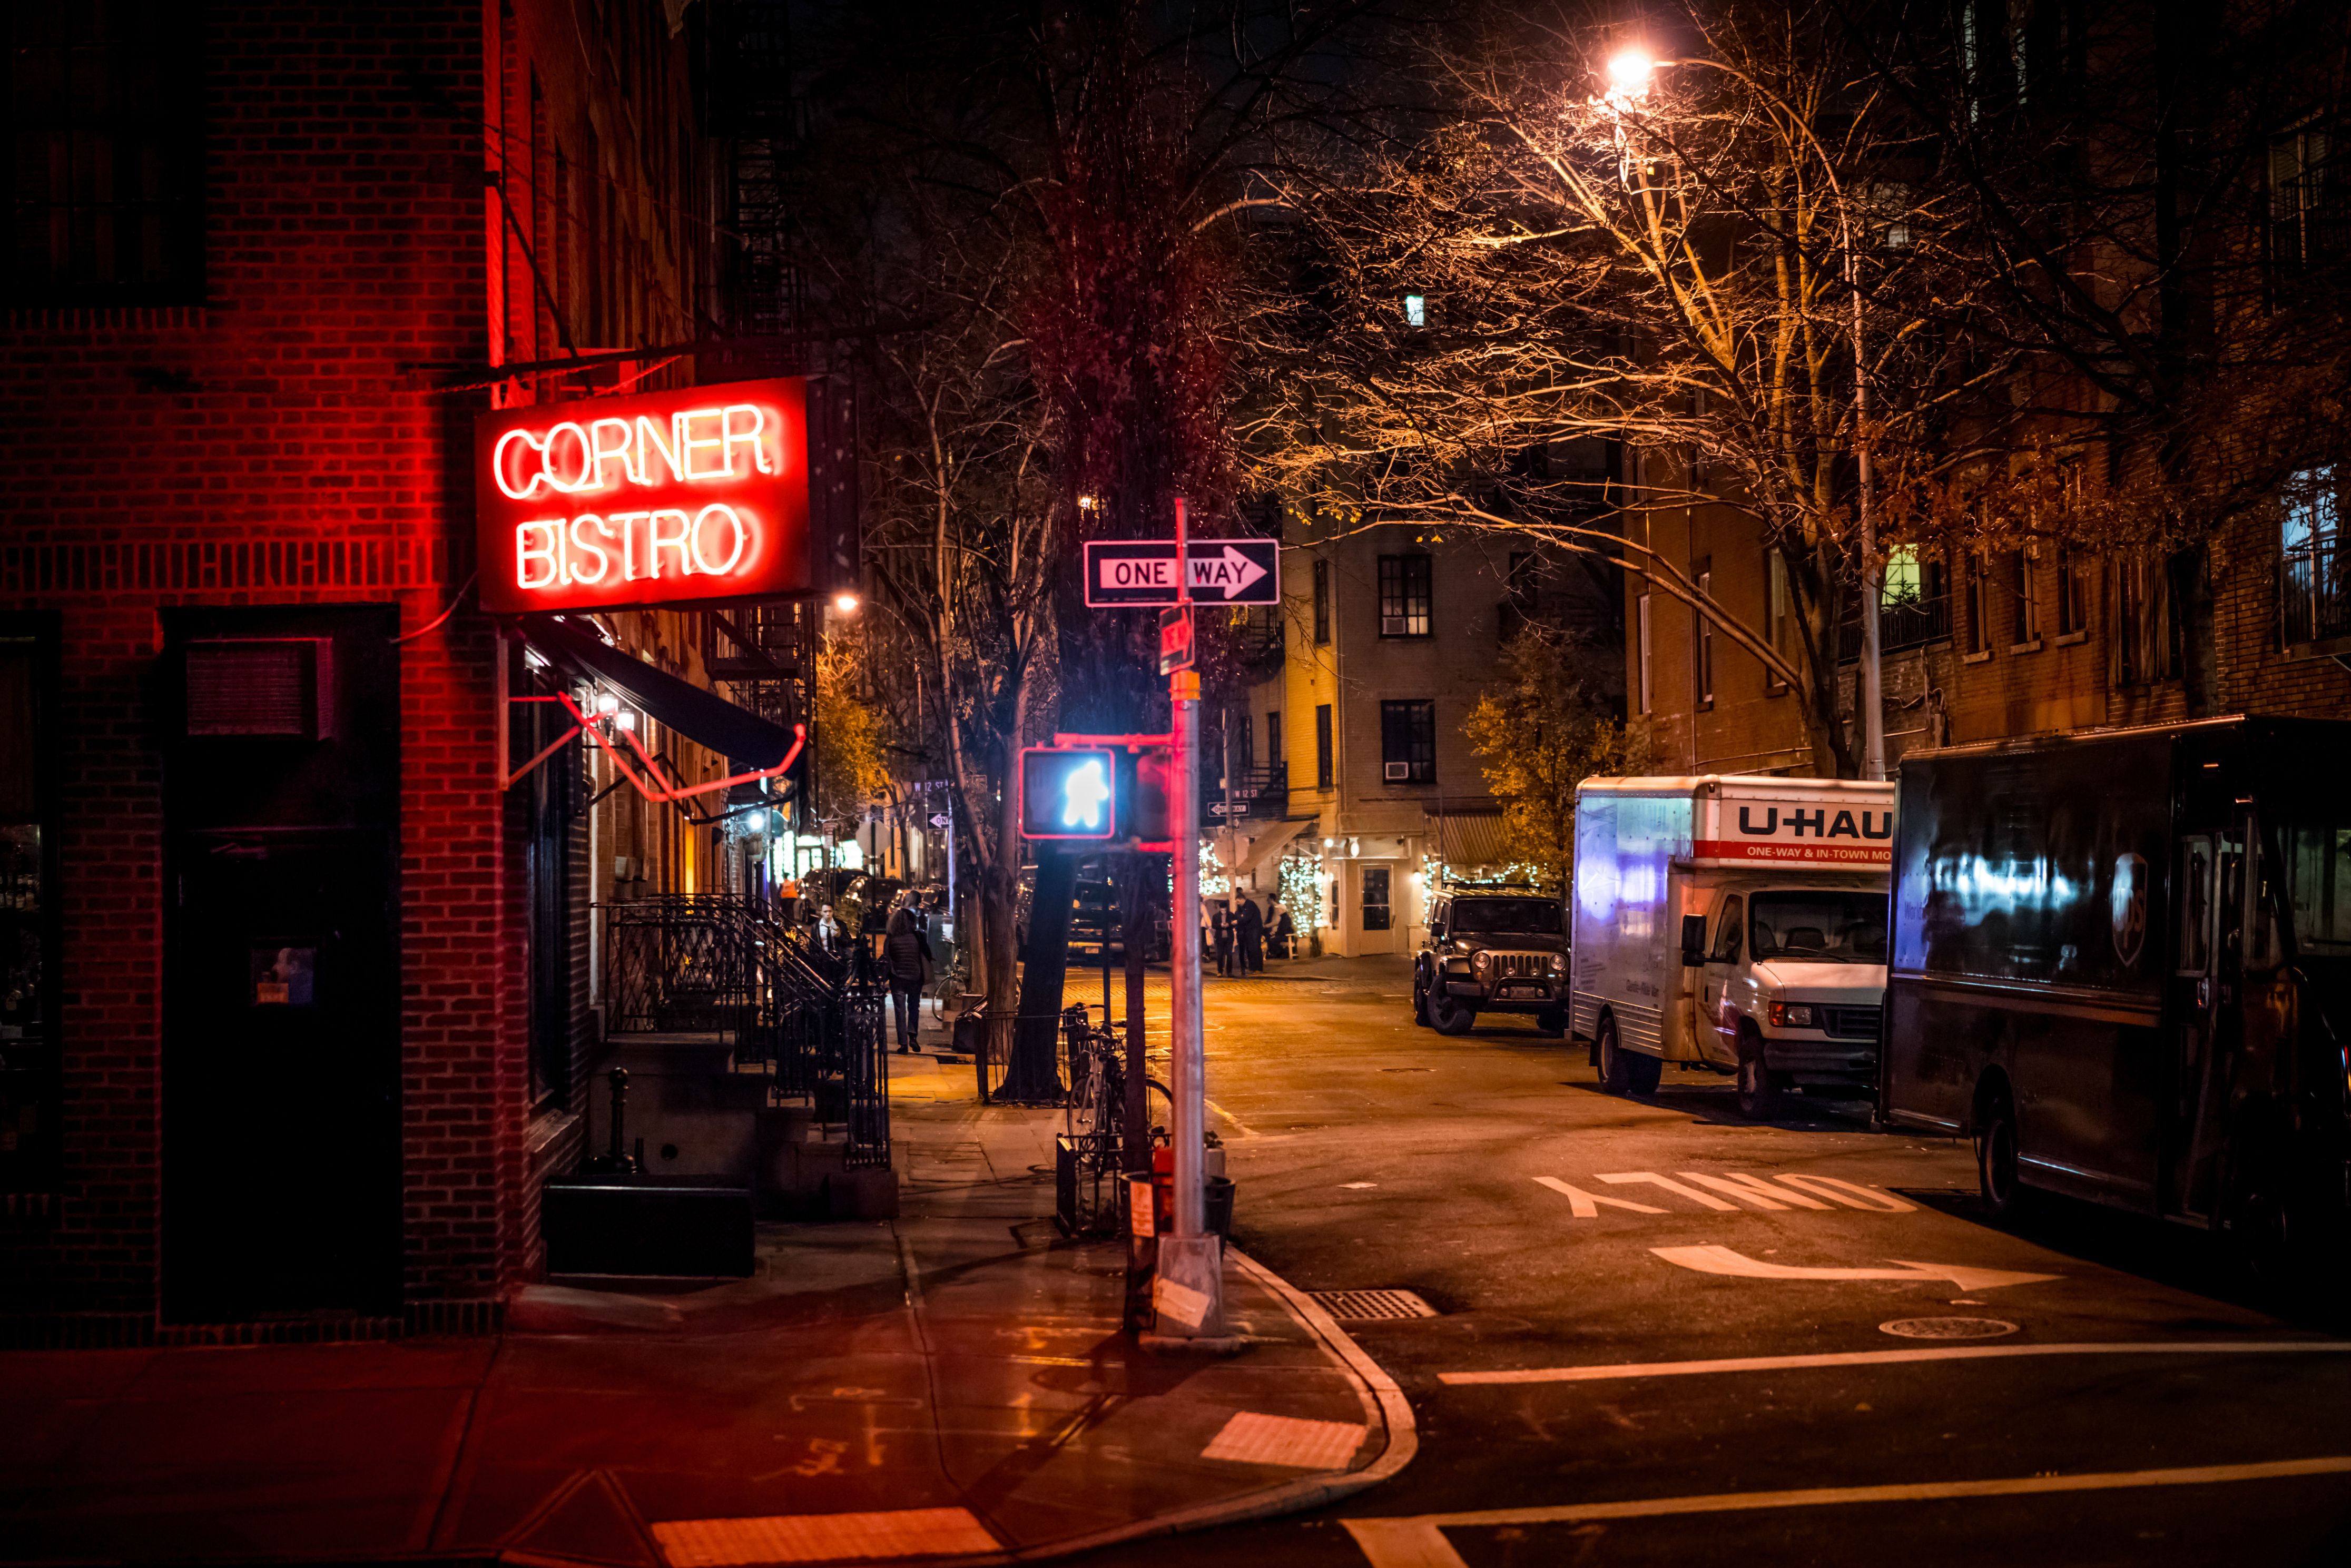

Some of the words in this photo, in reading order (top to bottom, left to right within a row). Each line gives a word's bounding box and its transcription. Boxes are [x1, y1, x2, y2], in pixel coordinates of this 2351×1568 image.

[493, 404, 772, 499] CORNER
[516, 503, 744, 589] BISTRO
[1115, 563, 1168, 585] ONE
[1193, 561, 1247, 584] WAY
[914, 782, 921, 792] W
[924, 782, 931, 791] 12
[1747, 846, 1802, 857] ONE-WAY
[1804, 849, 1814, 858] &
[1817, 849, 1868, 860] IN-TOWN
[1531, 1171, 1919, 1218] ONLY
